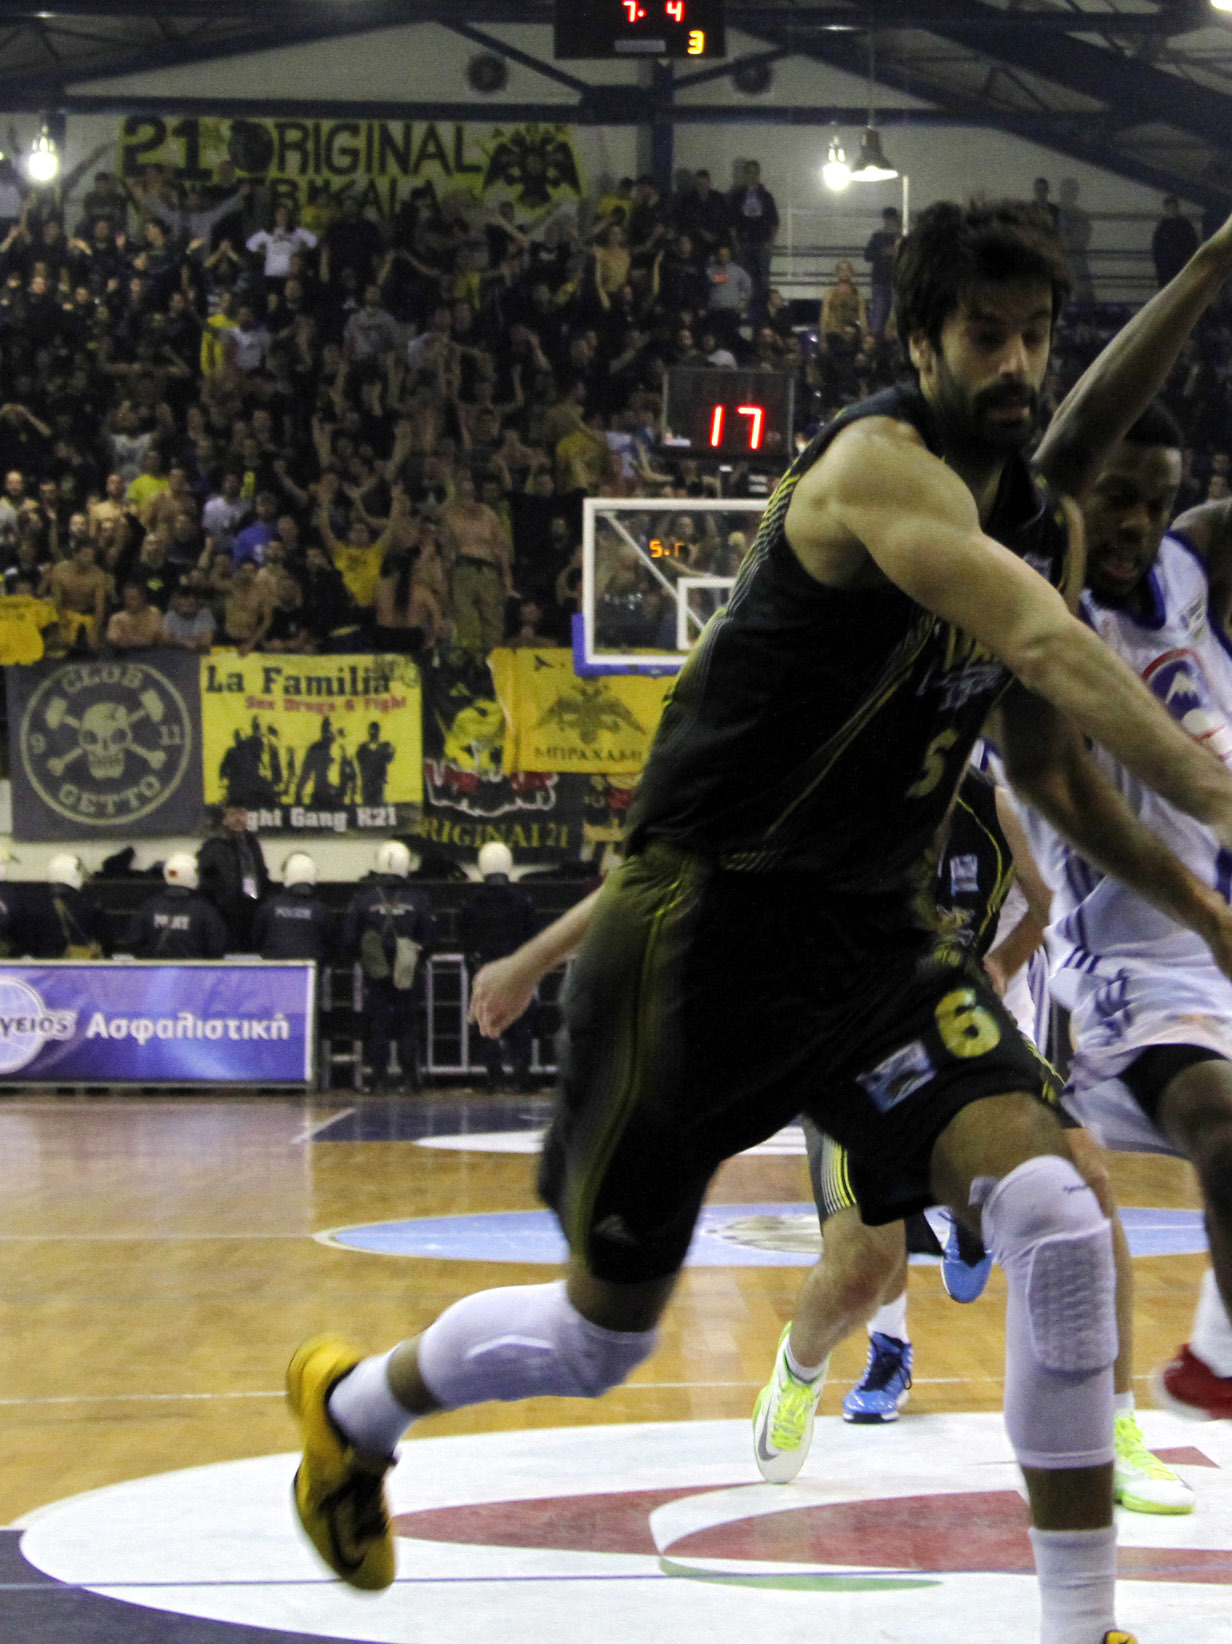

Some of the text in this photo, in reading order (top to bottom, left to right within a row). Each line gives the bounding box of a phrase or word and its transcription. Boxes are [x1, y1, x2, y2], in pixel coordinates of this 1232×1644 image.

[687, 30, 705, 55] 3
[122, 116, 482, 181] 21 ORIGINAL
[710, 403, 764, 450] 17
[61, 664, 143, 694] CLUB
[206, 664, 391, 697] La Familia
[290, 807, 347, 833] Gang
[86, 1011, 291, 1046] Ασφαλιστική
[935, 988, 1001, 1058] 6
